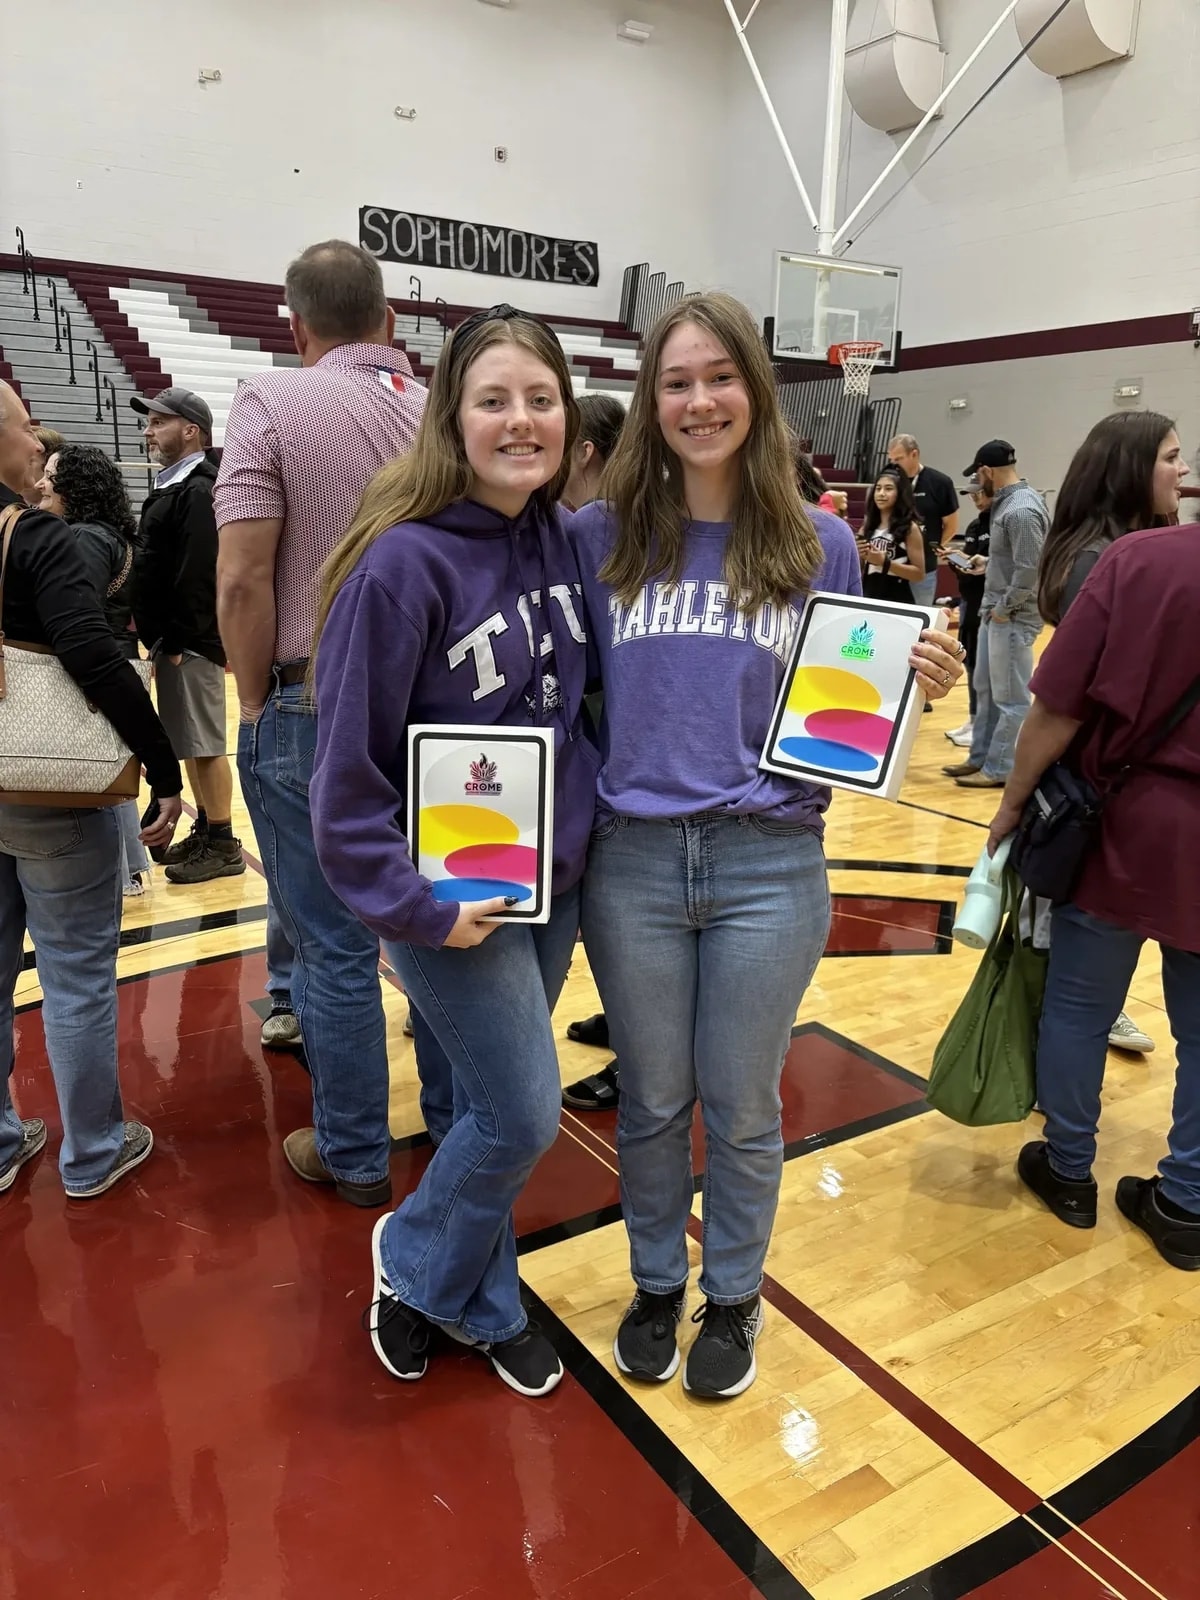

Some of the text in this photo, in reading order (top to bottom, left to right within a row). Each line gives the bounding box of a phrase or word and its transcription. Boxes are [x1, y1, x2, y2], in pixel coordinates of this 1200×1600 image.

[360, 207, 595, 286] SOPHOMORES
[840, 645, 876, 657] CROME
[465, 782, 503, 792] CROME
